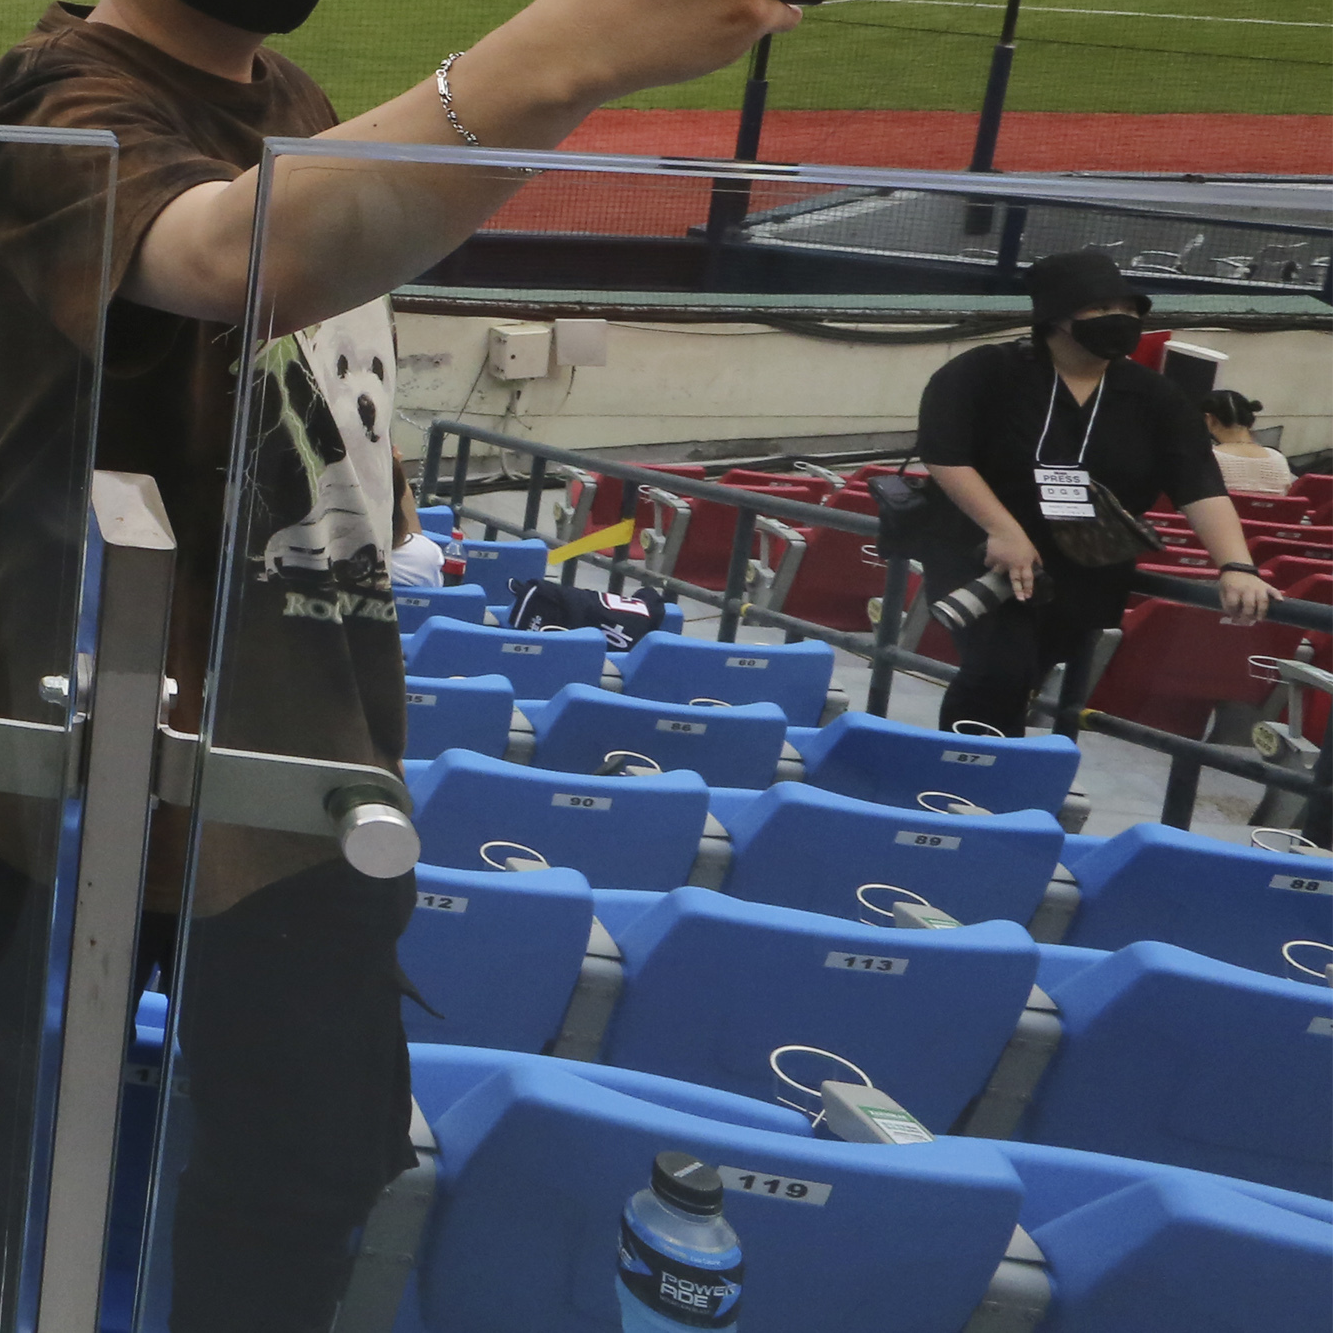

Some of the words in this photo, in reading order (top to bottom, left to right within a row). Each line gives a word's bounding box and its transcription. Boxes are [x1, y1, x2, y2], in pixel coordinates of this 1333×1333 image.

[1042, 474, 1082, 484] PRESS
[513, 645, 526, 653] 61
[956, 753, 979, 764] 87
[570, 796, 594, 807] 90
[915, 835, 942, 846] 89
[1289, 879, 1320, 892] 88
[843, 955, 893, 973] 113
[737, 1173, 809, 1200] 119
[661, 1270, 736, 1297] POWER
[659, 1282, 709, 1309] ADE
